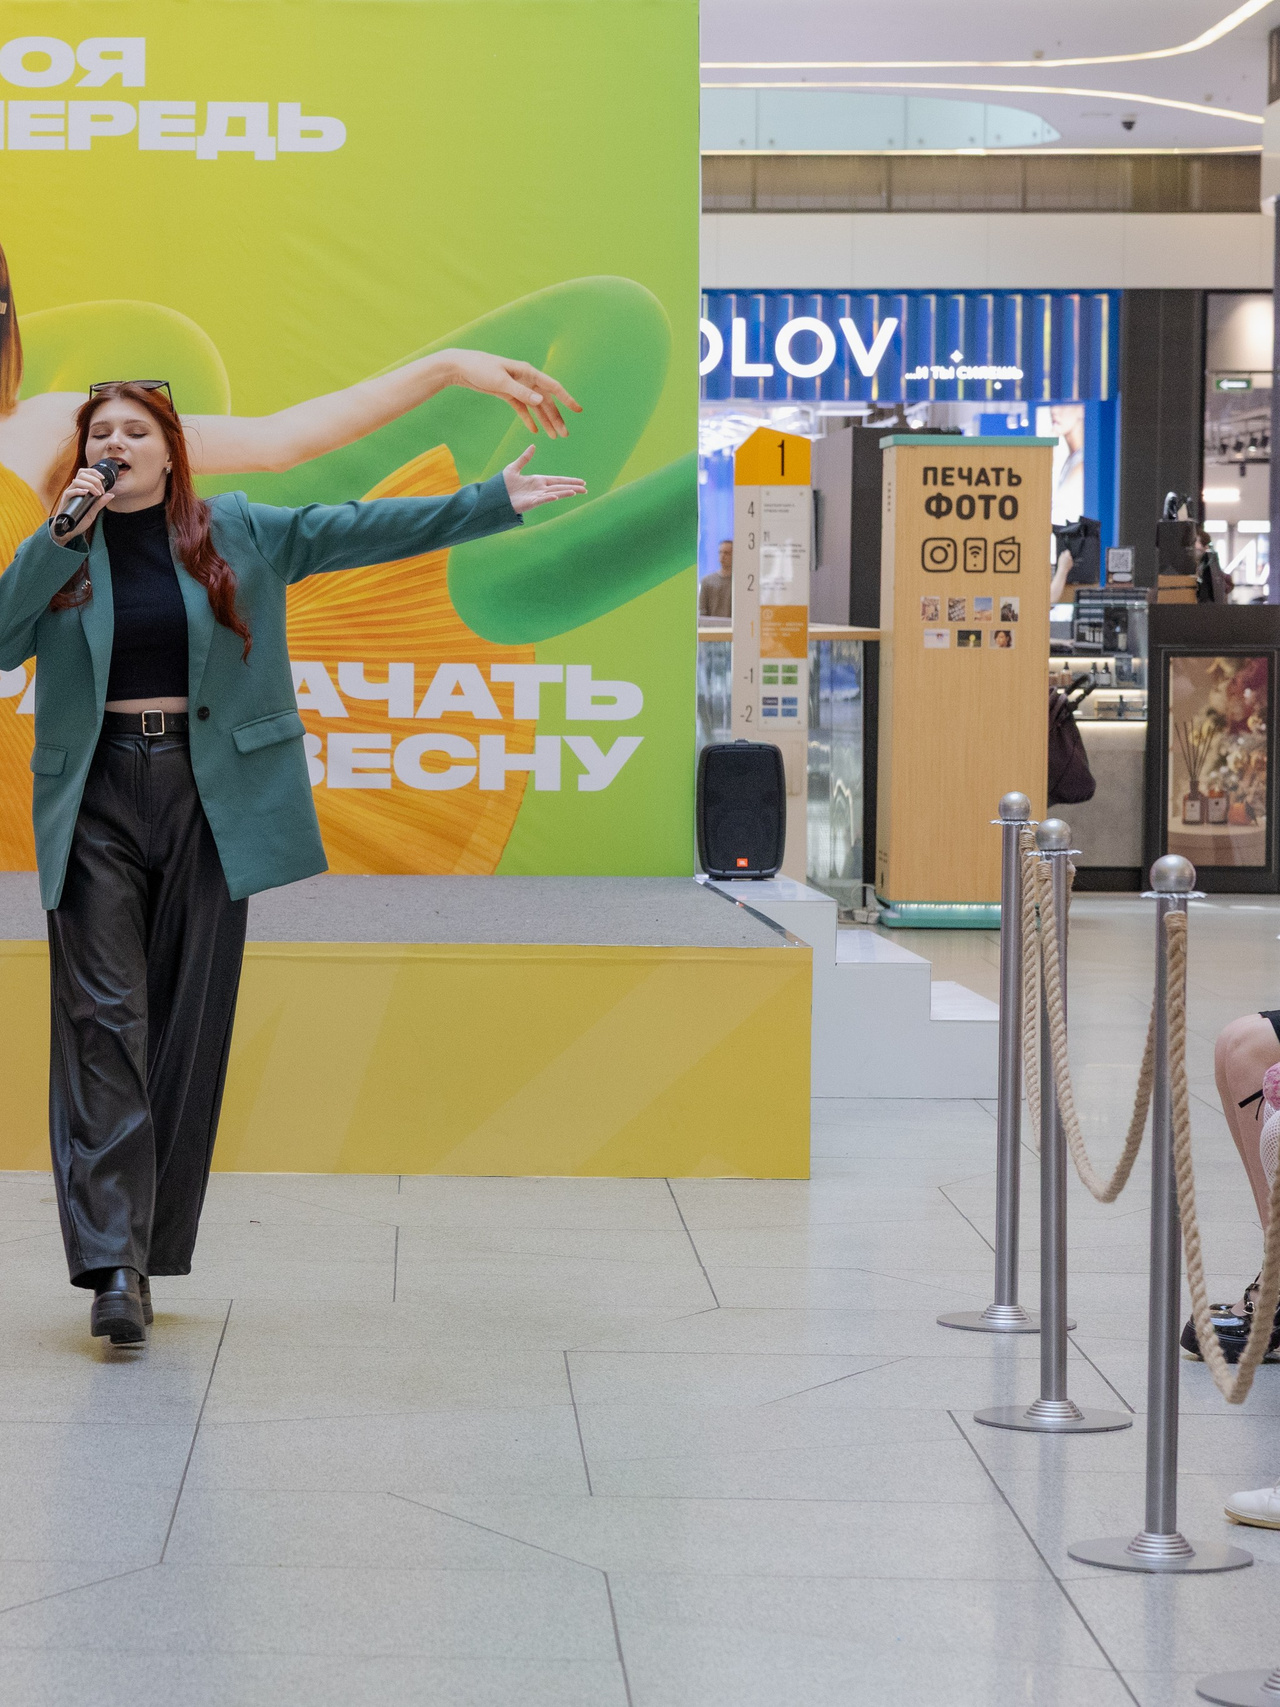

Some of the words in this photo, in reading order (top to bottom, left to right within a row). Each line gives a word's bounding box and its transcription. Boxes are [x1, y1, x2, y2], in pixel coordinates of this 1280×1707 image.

[777, 439, 785, 476] 1
[922, 466, 1023, 487] ПЕЧАТЬ
[747, 501, 755, 518] 4
[924, 492, 1019, 520] ФОТО
[748, 532, 755, 550] 3
[747, 574, 755, 591] 2
[740, 704, 753, 723] -2
